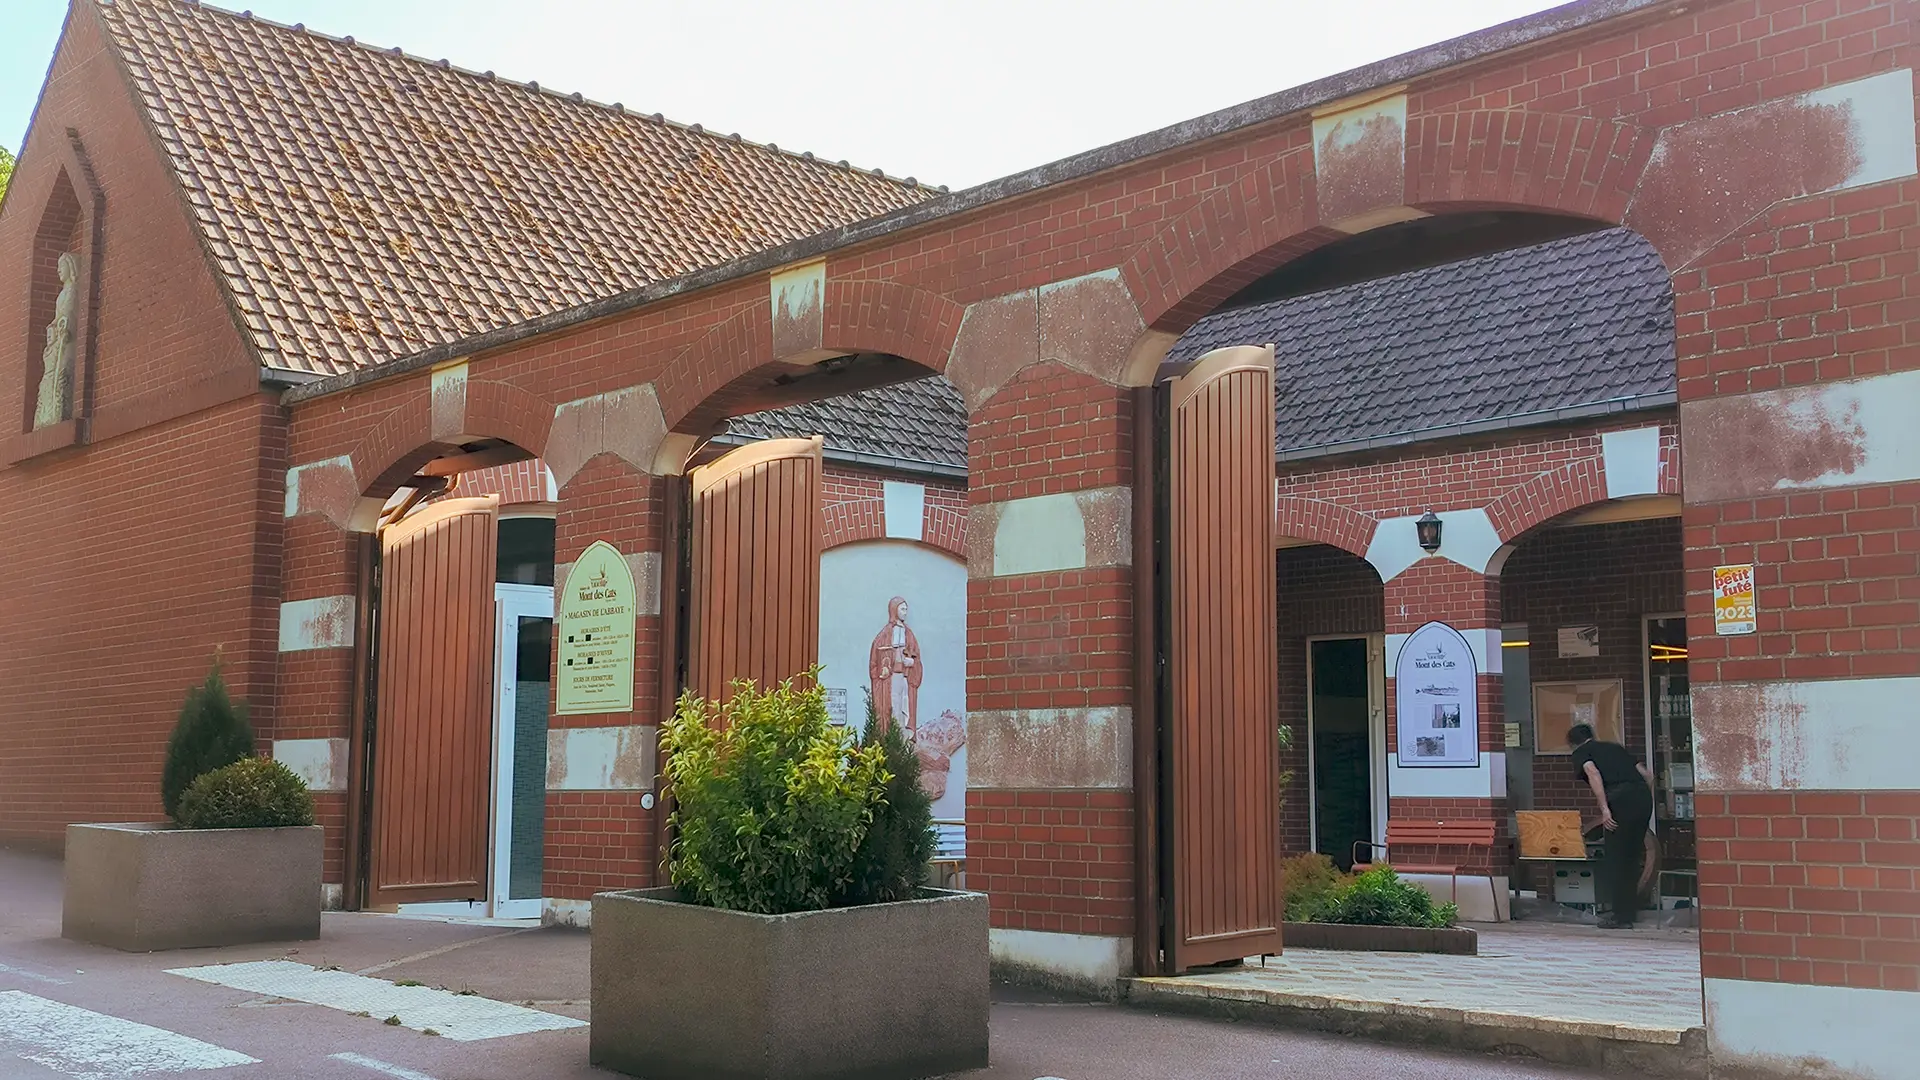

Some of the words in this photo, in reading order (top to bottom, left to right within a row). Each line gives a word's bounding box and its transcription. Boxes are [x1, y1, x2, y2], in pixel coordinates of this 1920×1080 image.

[1715, 568, 1749, 589] petit
[579, 592, 593, 601] Mont
[594, 589, 604, 600] des
[605, 588, 617, 598] Cats
[1722, 580, 1752, 597] futé
[568, 609, 592, 619] MAGASIN
[592, 608, 599, 617] DE
[600, 606, 624, 616] L'ABBAYE
[1717, 605, 1754, 620] 2023
[1442, 660, 1456, 668] Cats
